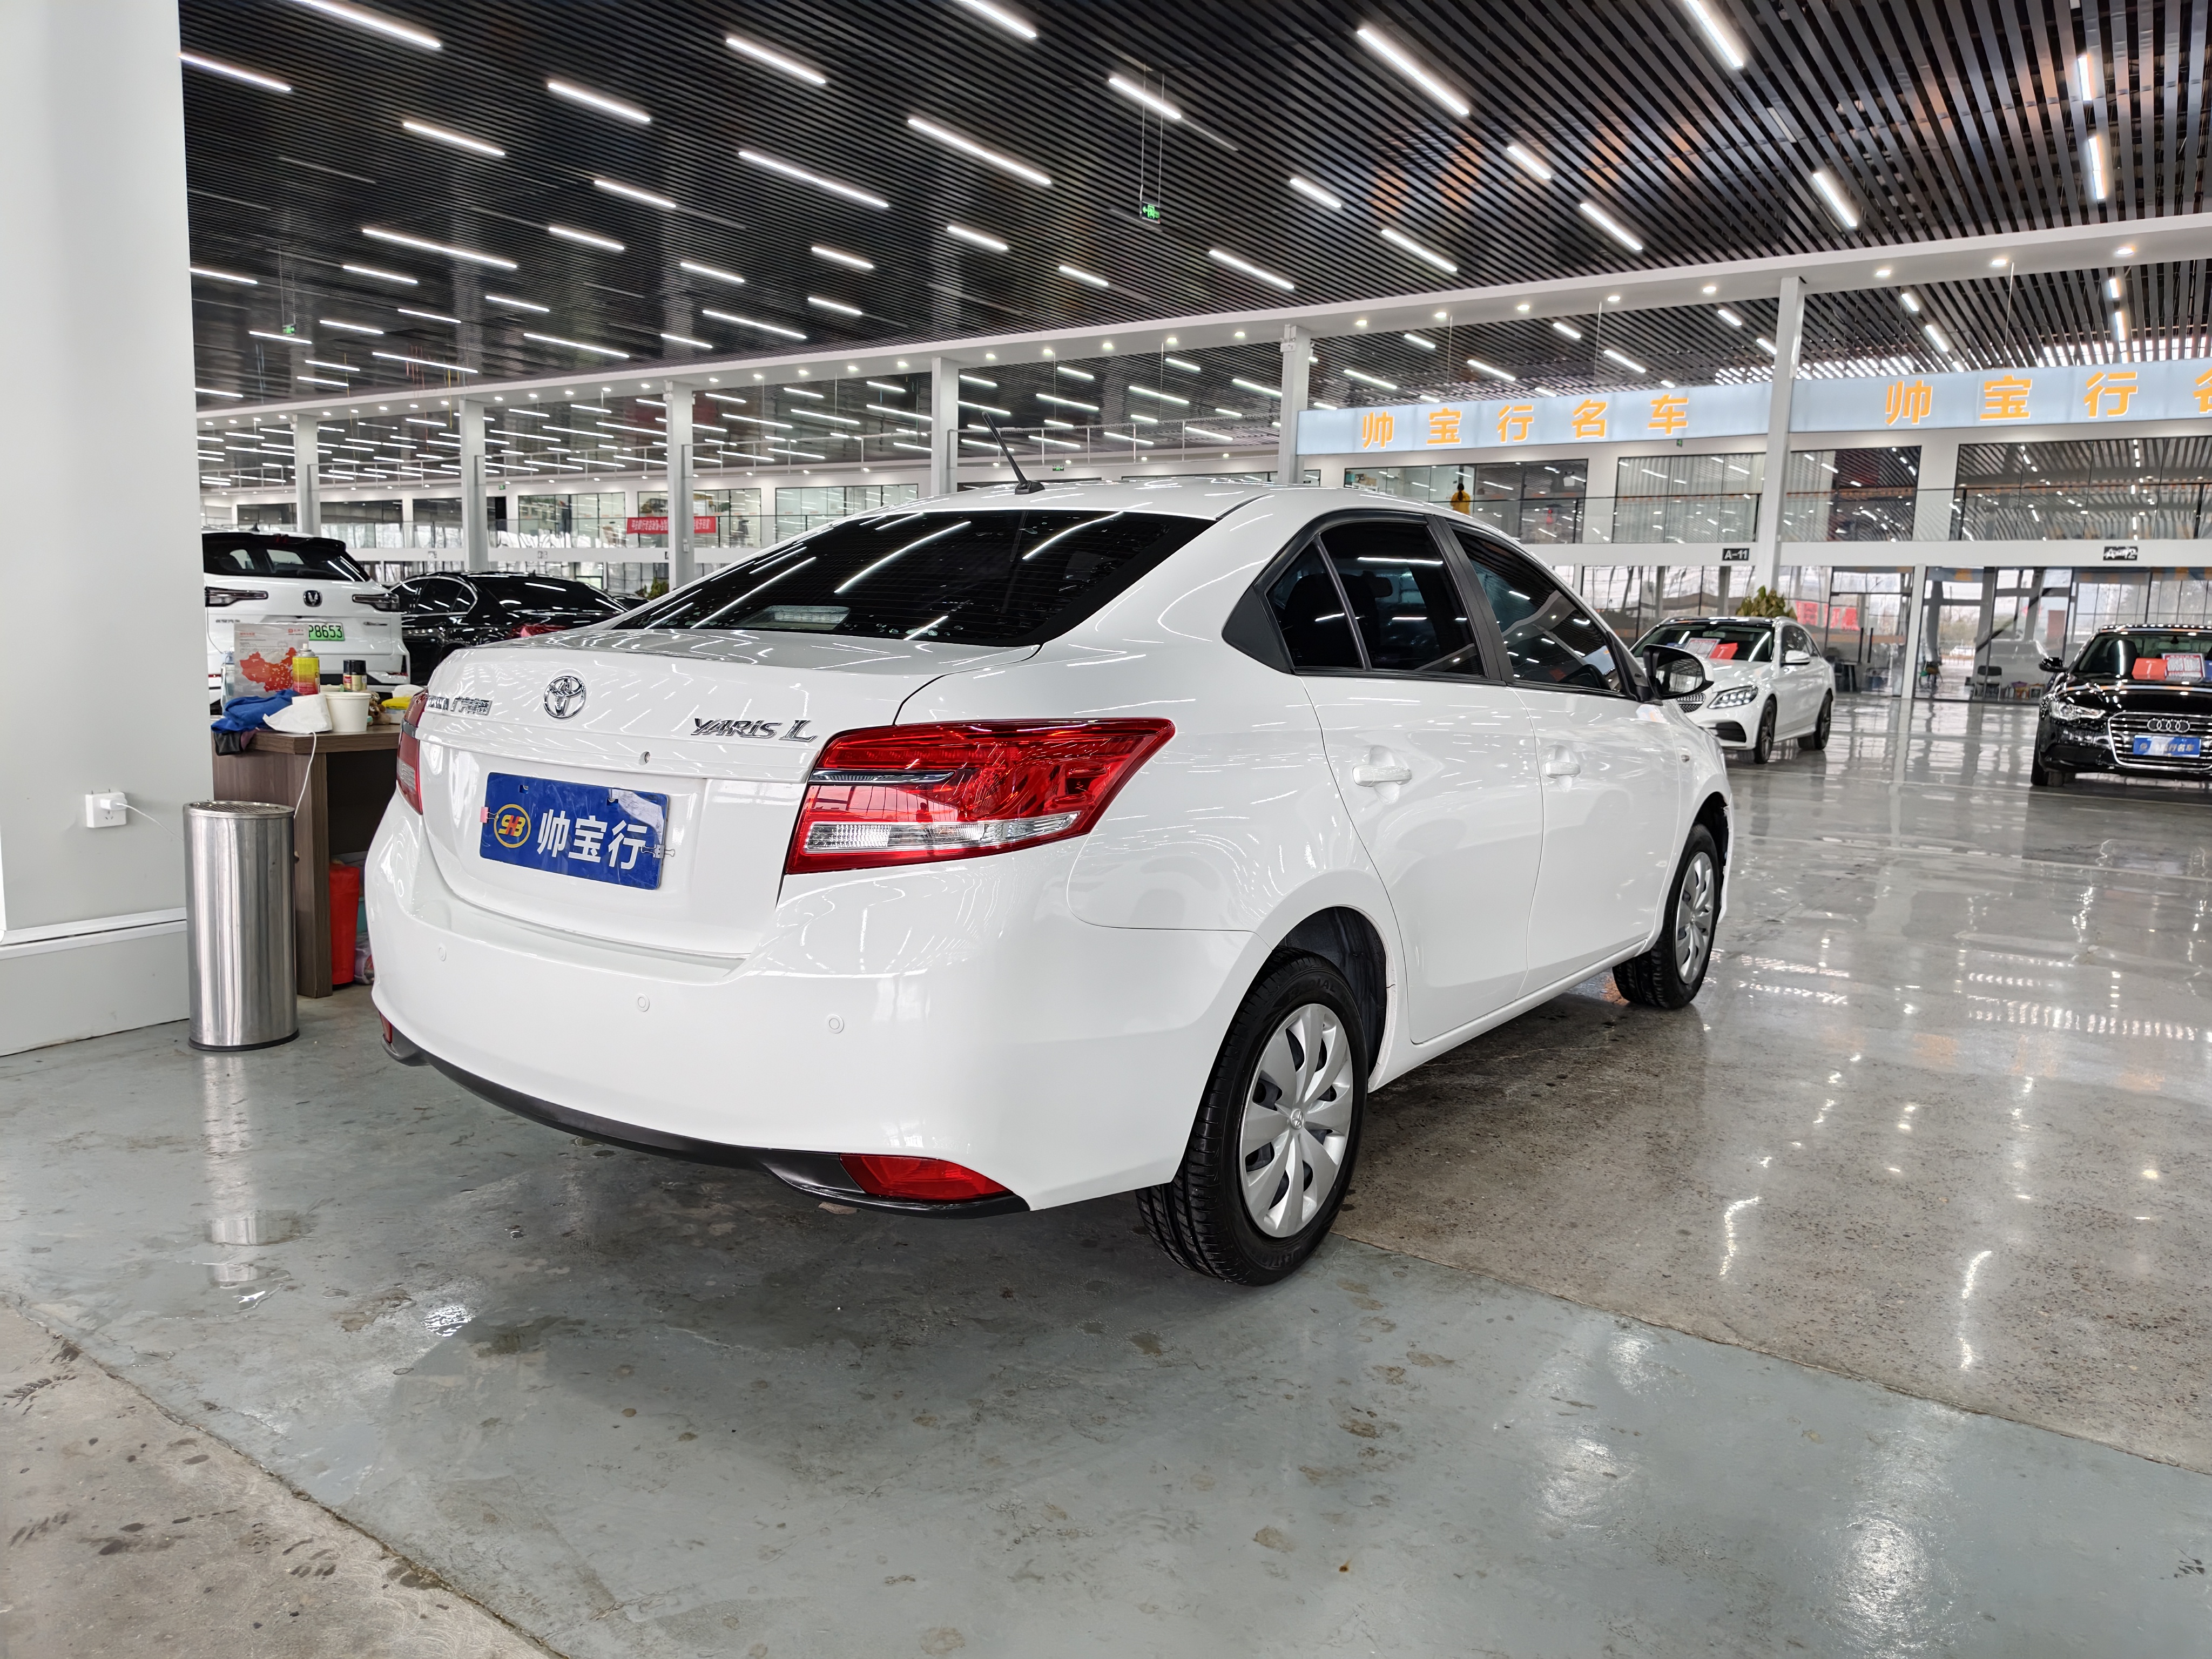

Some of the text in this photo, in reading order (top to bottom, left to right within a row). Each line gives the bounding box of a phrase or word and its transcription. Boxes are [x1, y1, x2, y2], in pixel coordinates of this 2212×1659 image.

[1361, 394, 1689, 449] 帅宝行名车
[1724, 549, 1748, 559] A-11
[778, 720, 818, 743] L
[537, 808, 648, 870] 帅宝行
